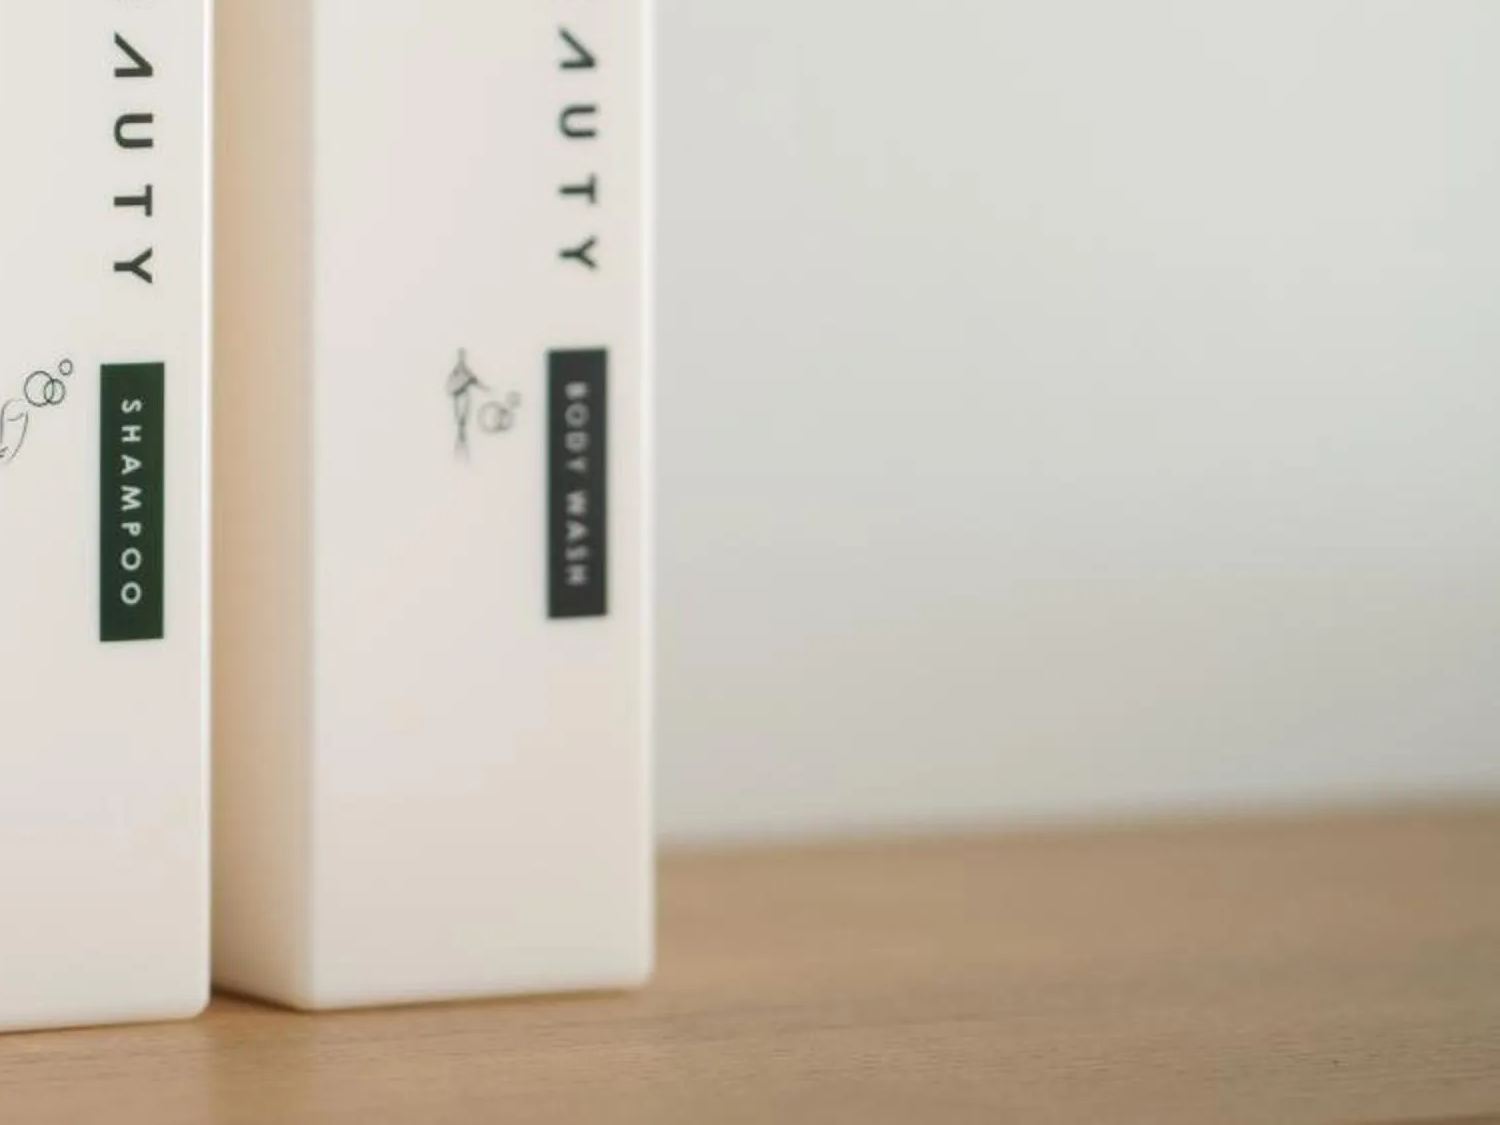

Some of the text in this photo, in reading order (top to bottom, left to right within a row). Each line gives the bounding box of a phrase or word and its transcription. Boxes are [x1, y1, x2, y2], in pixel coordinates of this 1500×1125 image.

[119, 398, 143, 606] SHAMPOO
[564, 380, 590, 587] BODY WASH
